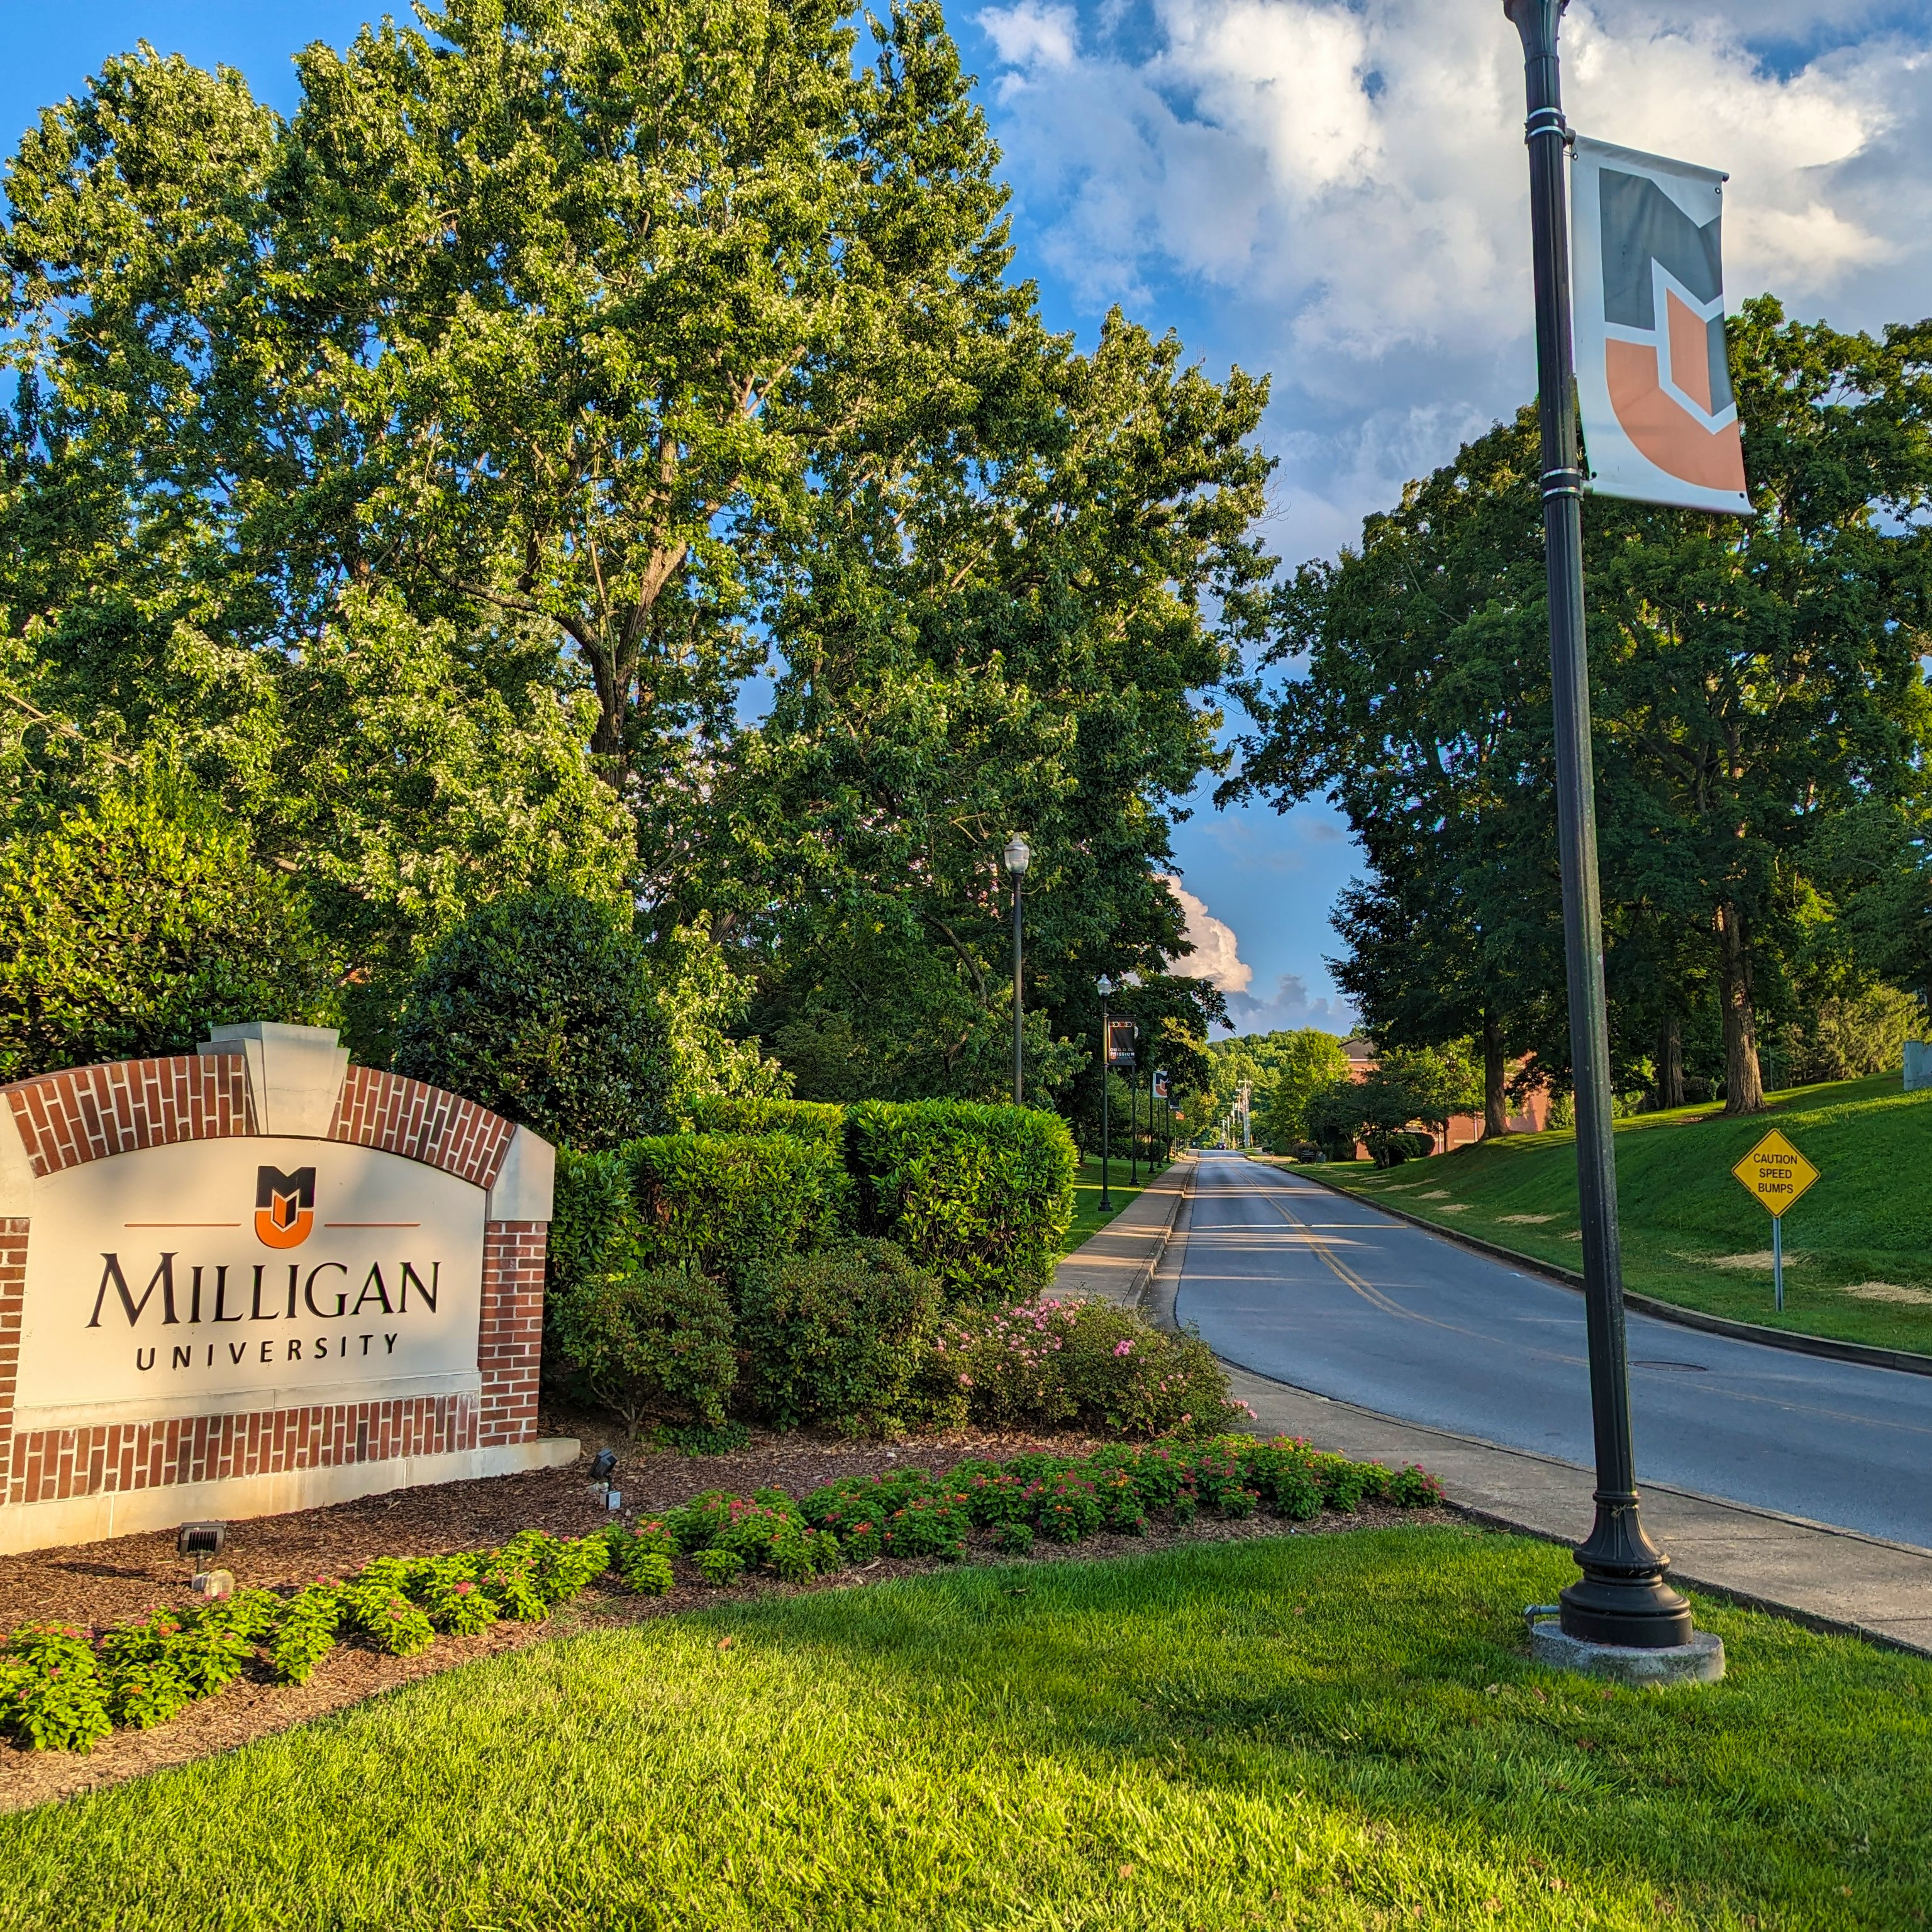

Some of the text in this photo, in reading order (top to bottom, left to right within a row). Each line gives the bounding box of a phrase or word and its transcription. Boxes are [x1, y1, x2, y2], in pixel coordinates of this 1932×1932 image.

[1753, 1153, 1798, 1165] CAUTION
[1758, 1168, 1792, 1179] SPEED
[1758, 1182, 1794, 1194] BUMPS
[84, 1252, 441, 1328] MILLIGAN
[136, 1333, 398, 1371] UNIVERSITY
